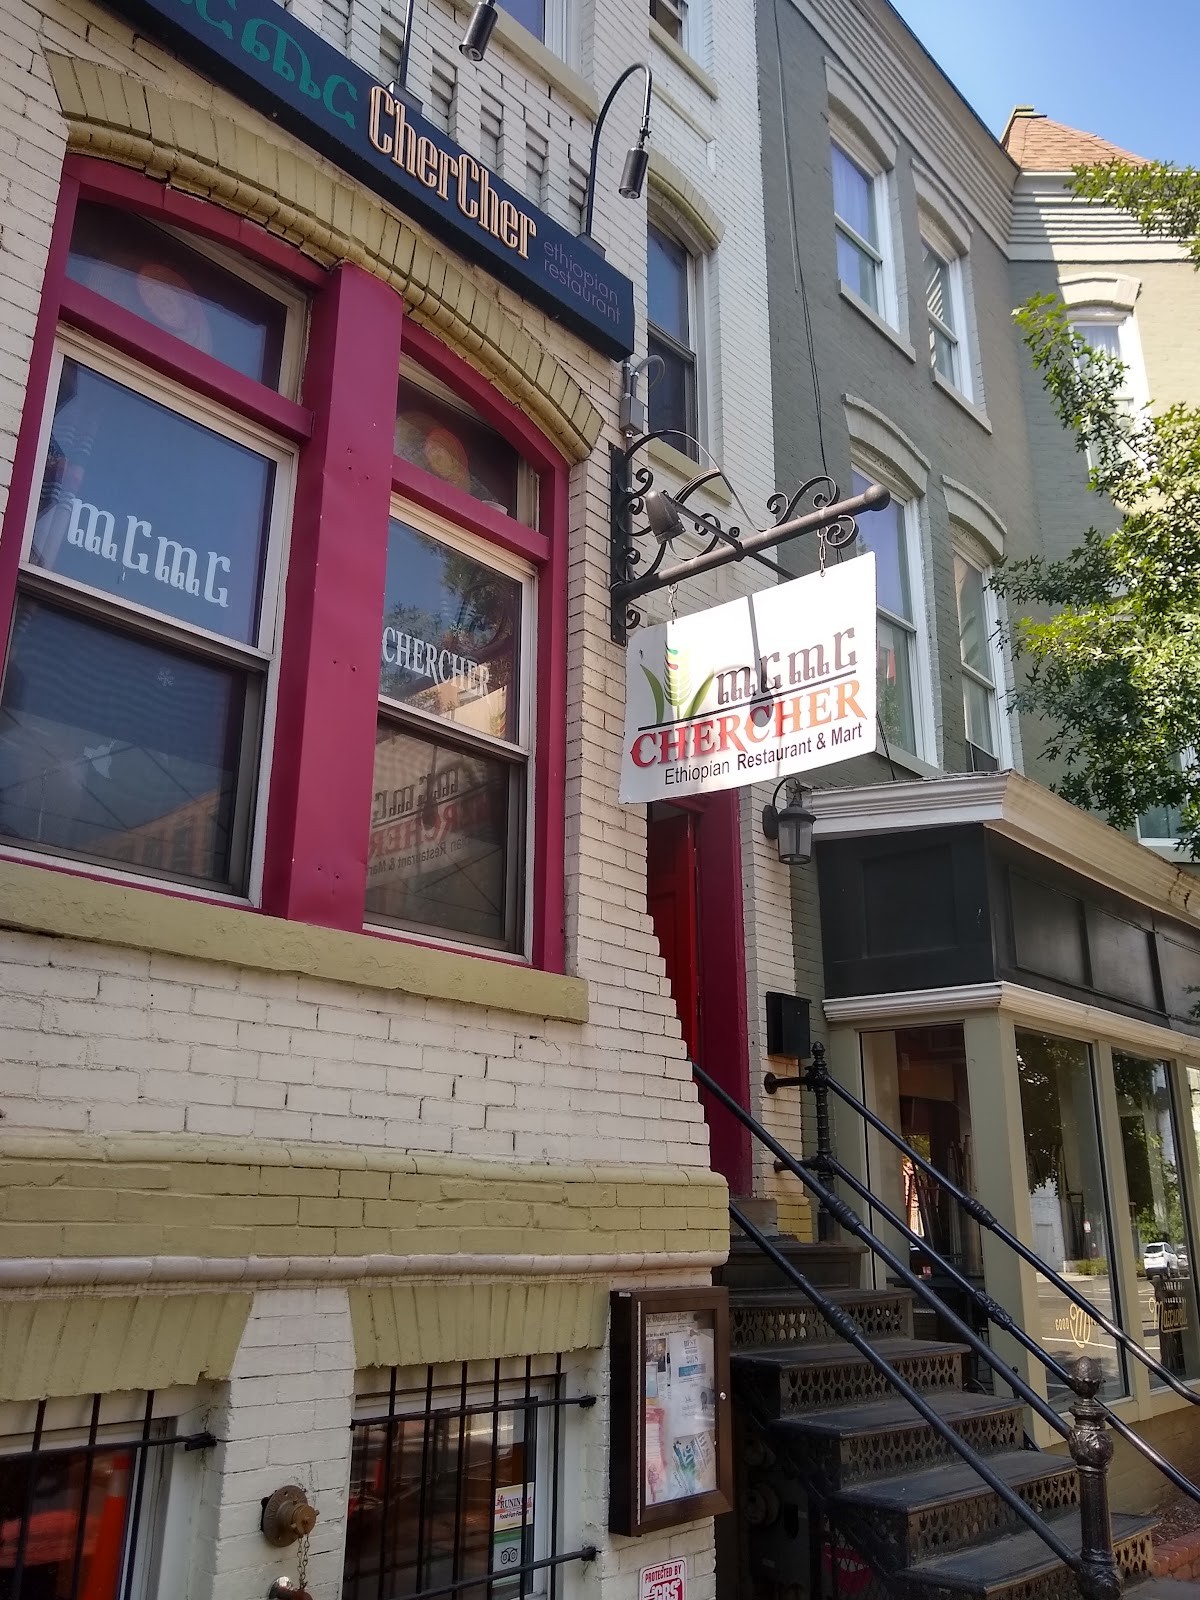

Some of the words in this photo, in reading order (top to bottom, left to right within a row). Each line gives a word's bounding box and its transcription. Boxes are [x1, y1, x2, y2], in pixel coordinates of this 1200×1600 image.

[180, 0, 358, 129] ርጨር
[369, 86, 537, 260] CherCher
[543, 241, 618, 305] ethiopian
[543, 258, 621, 324] restaurant
[382, 626, 490, 697] CHERCHER
[630, 679, 868, 768] CHERCHER
[664, 760, 730, 786] Ethiopian
[737, 737, 812, 771] Restaurant
[816, 732, 826, 750] &
[831, 723, 862, 746] Mart
[645, 1567, 672, 1584] PROTECTED
[674, 1565, 681, 1576] BY
